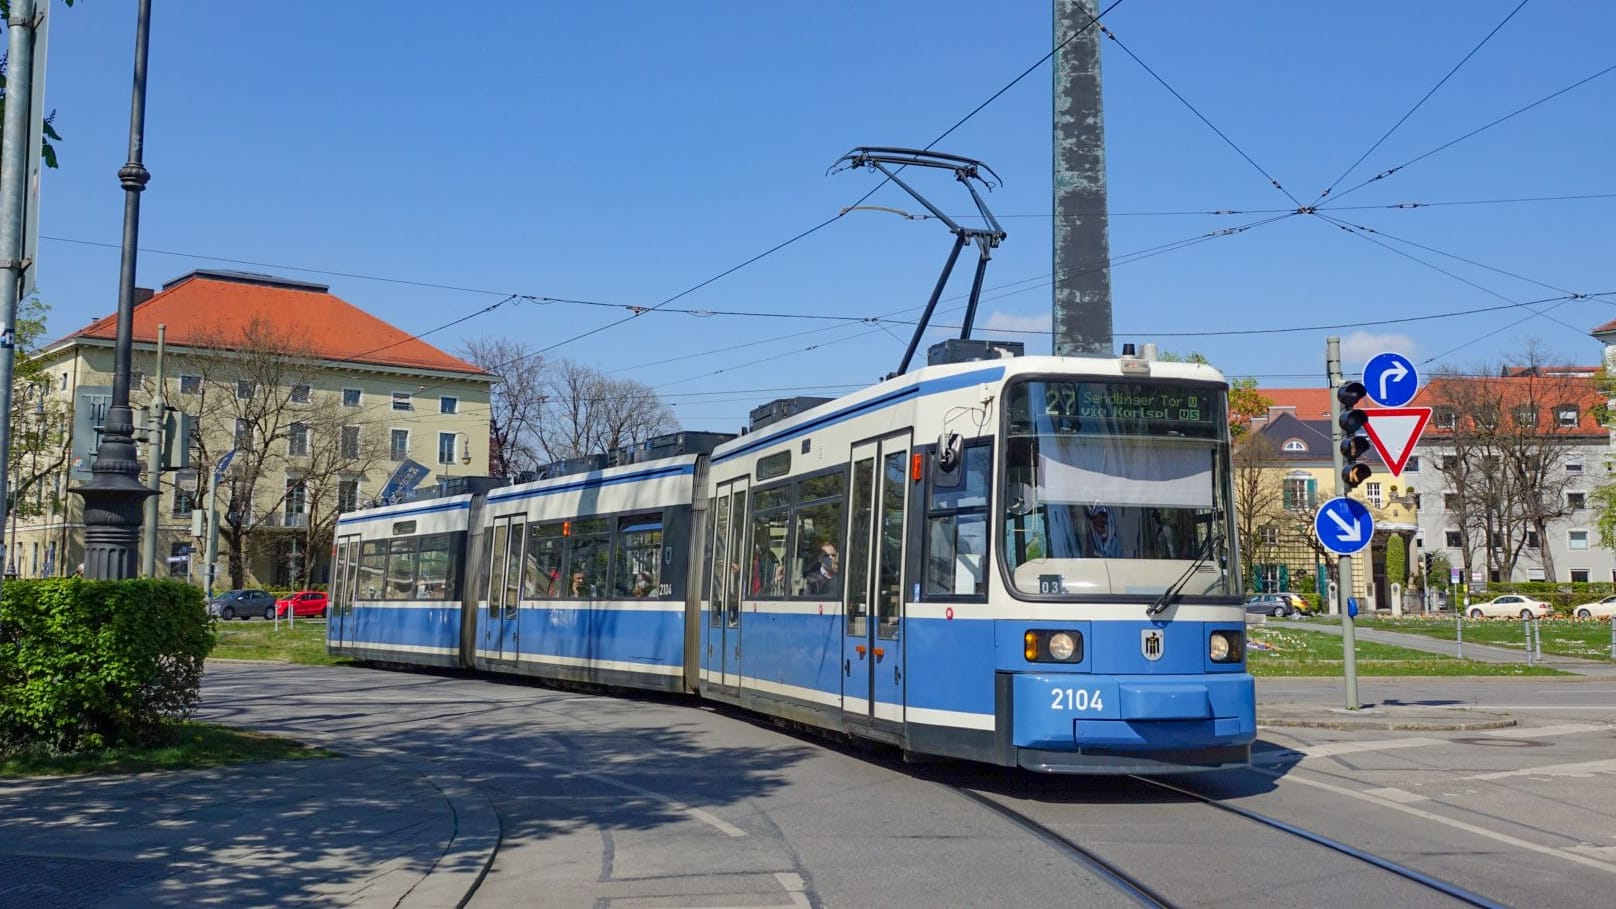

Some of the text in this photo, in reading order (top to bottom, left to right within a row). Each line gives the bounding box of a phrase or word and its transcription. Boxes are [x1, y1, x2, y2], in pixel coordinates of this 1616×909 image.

[1046, 391, 1076, 416] 27
[1084, 391, 1154, 406] Sendlinger
[1160, 394, 1183, 408] Tor
[1081, 407, 1107, 417] via
[659, 583, 672, 596] 2104
[1051, 688, 1103, 711] 2104
